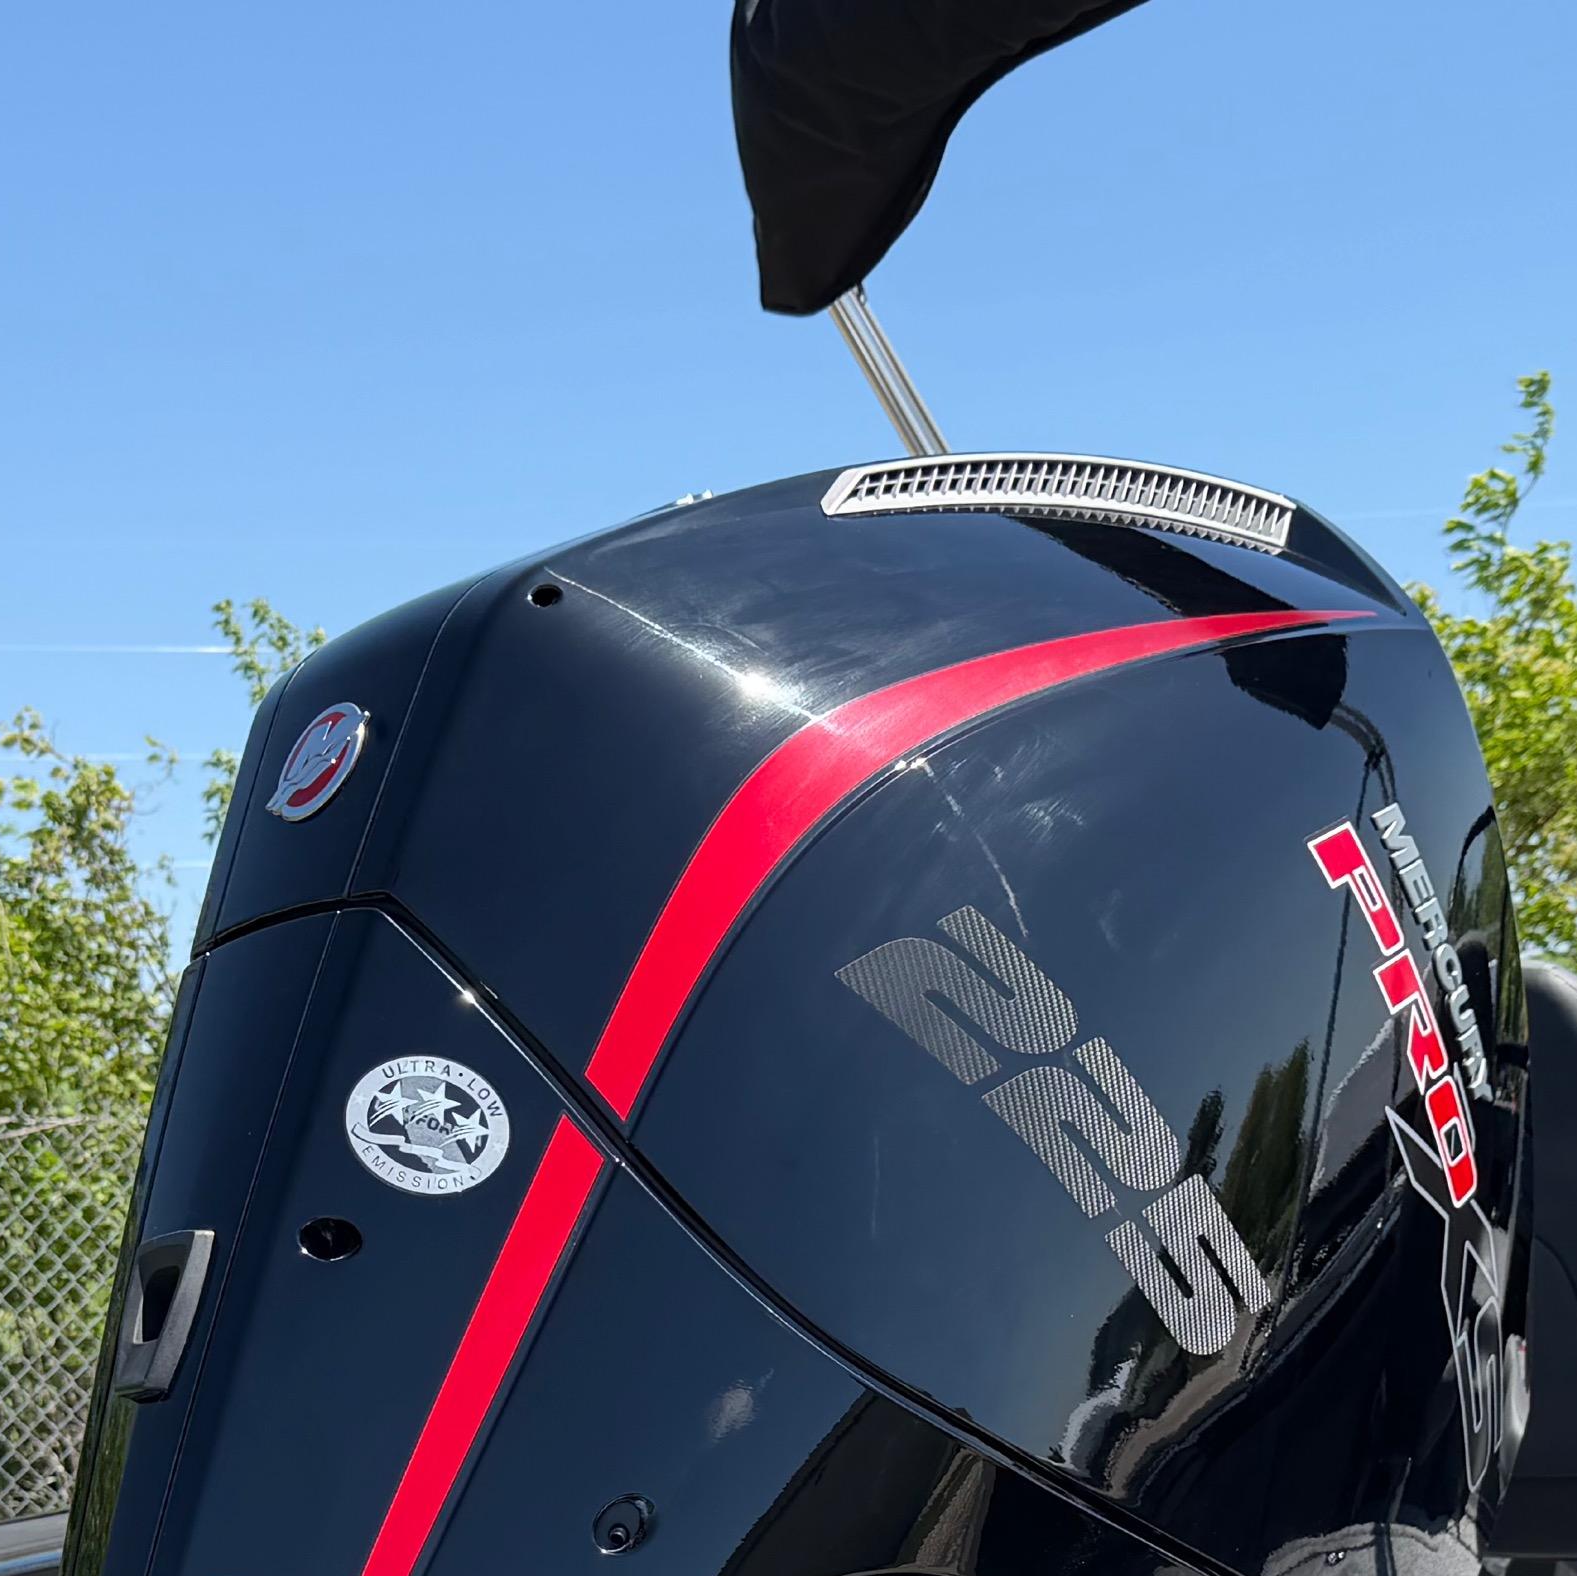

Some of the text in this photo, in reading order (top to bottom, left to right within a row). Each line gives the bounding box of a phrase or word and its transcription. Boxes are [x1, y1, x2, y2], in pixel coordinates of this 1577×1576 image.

[382, 1060, 504, 1118] ULTRA LOW
[1307, 820, 1478, 1208] PRO
[1371, 802, 1494, 1101] MERCURY
[833, 905, 1272, 1356] 225
